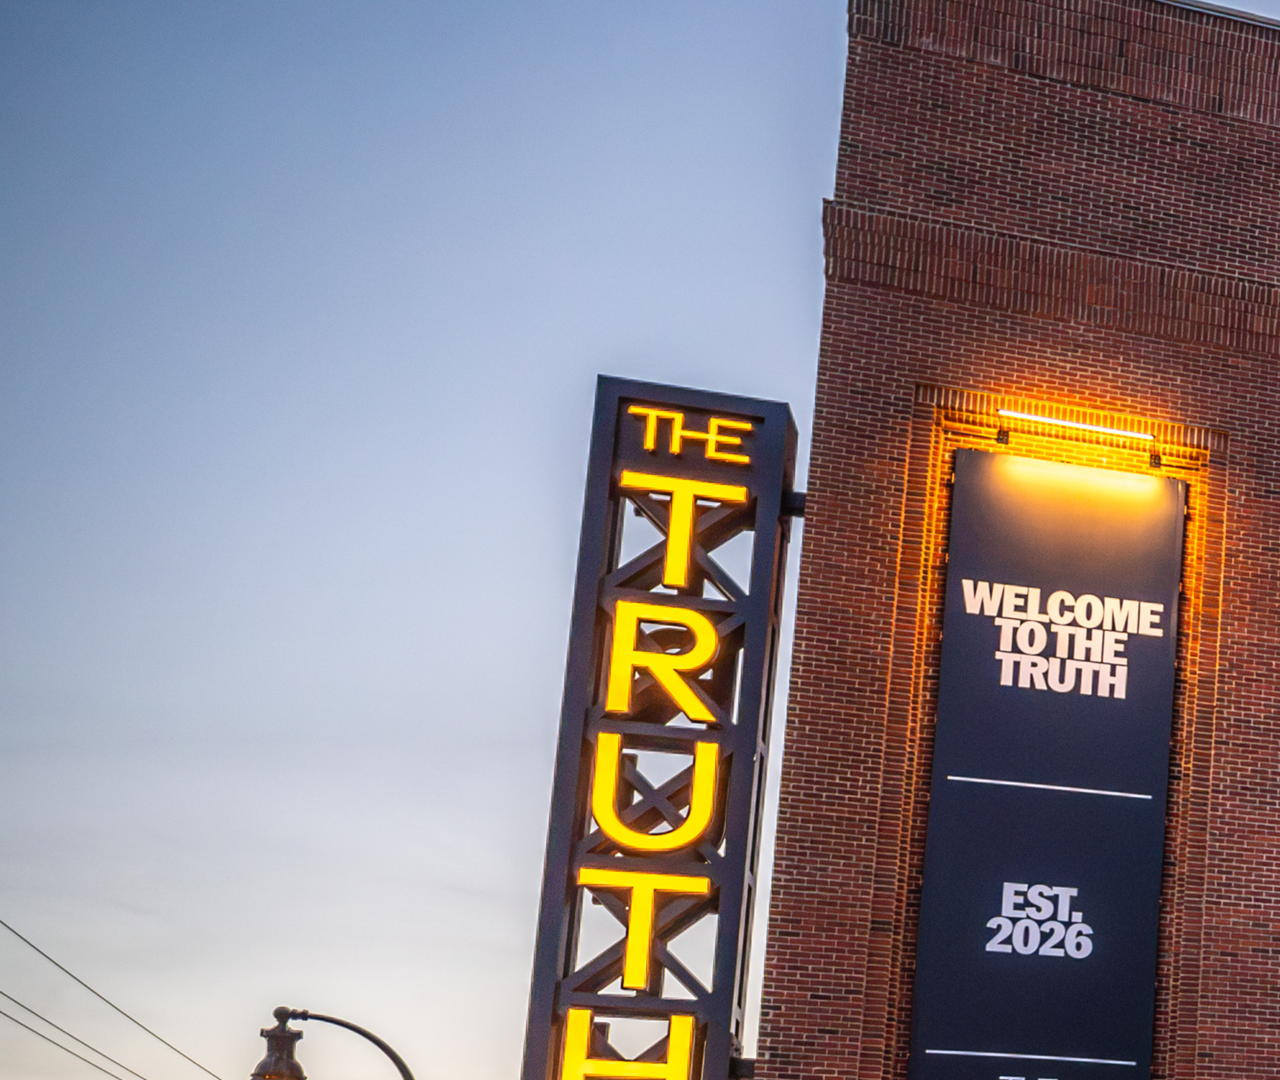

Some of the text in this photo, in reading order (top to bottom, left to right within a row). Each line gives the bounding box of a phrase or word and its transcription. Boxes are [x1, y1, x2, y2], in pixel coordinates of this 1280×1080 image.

[626, 404, 755, 464] THE
[961, 579, 1164, 638] WELCOME
[994, 617, 1128, 666] TO THE
[994, 651, 1128, 699] TRUTH
[1001, 881, 1083, 923] EST.
[985, 915, 1093, 959] 2026
